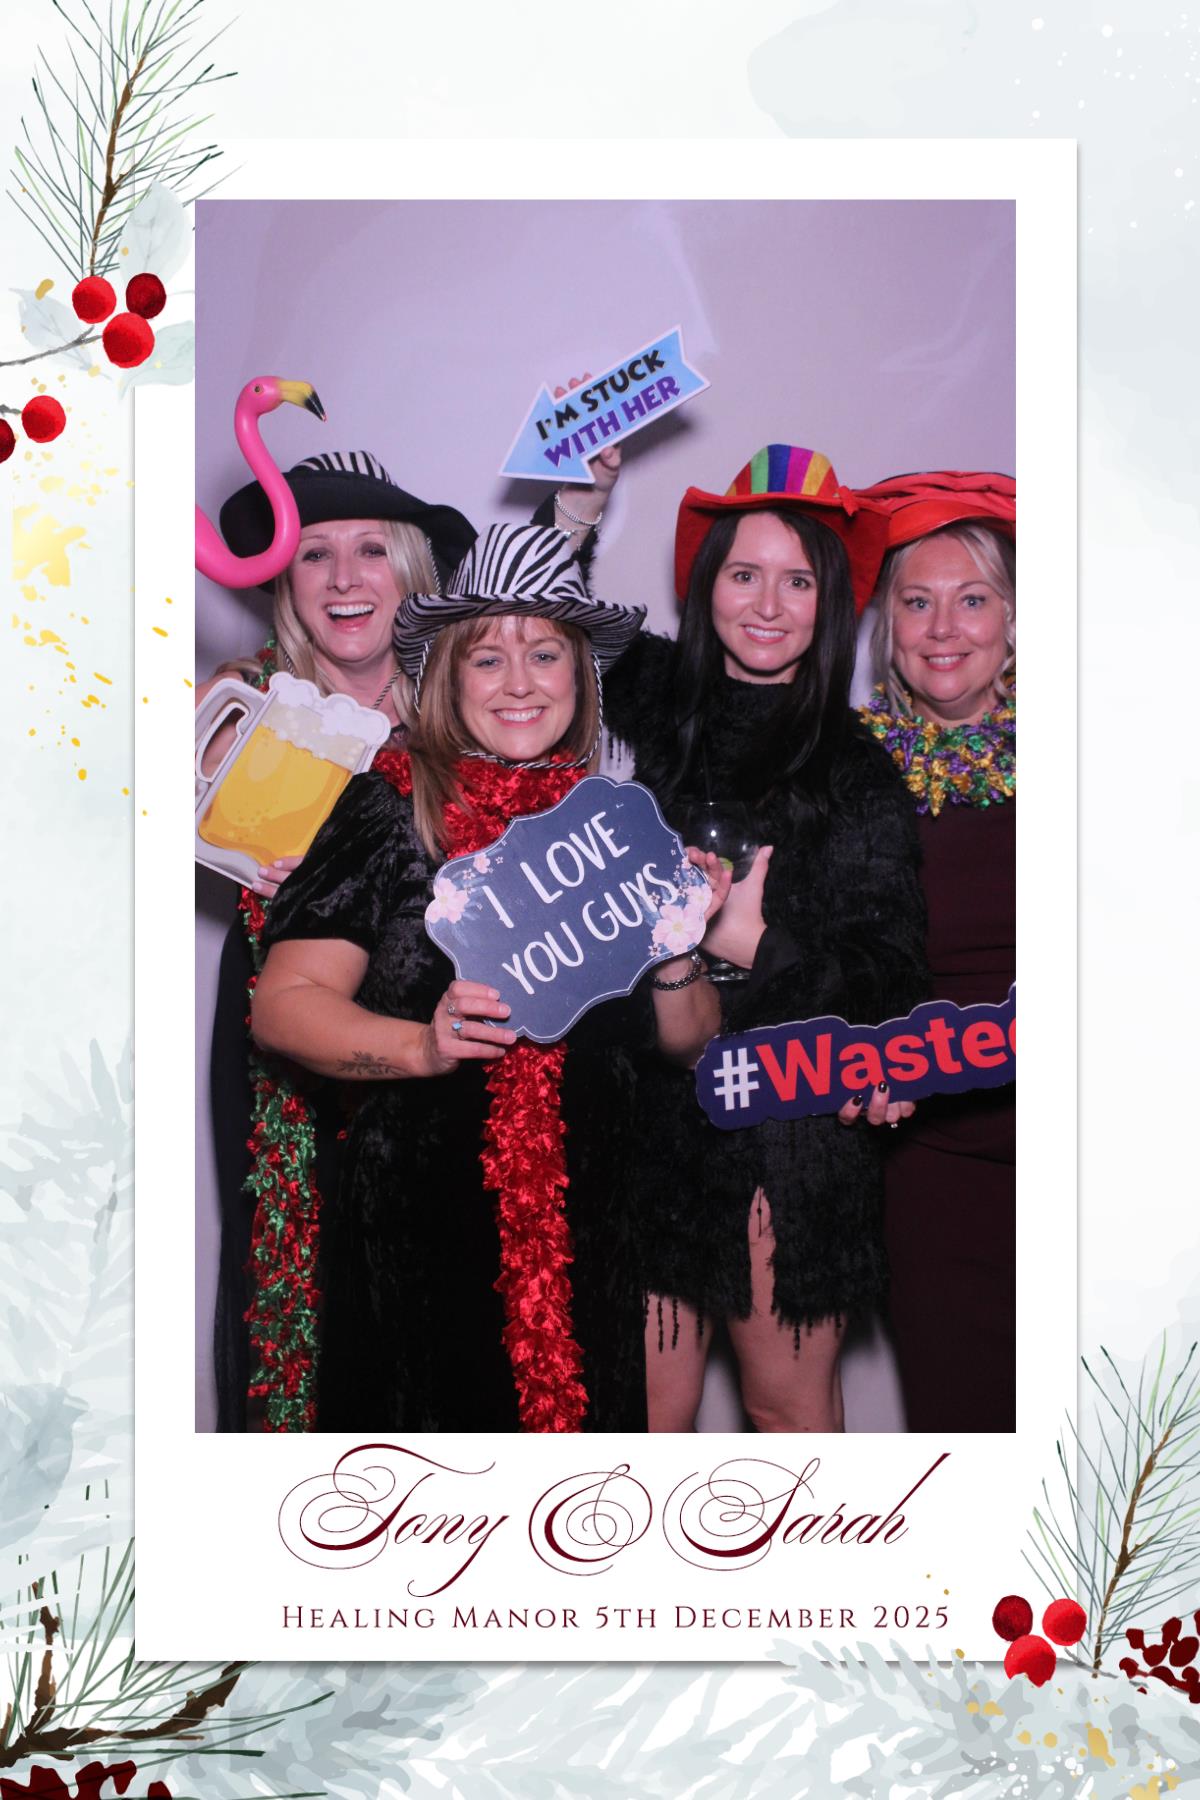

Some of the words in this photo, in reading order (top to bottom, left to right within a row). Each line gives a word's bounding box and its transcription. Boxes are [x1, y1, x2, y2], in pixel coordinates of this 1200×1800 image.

[535, 403, 579, 441] I'M
[580, 349, 665, 413] STUCK
[543, 410, 621, 468] WITH
[620, 375, 681, 423] HER
[482, 885, 514, 929] I
[520, 811, 630, 904] LOVE
[502, 921, 584, 995] YOU
[582, 863, 679, 942] GUYS
[713, 1016, 1016, 1111] #Waste
